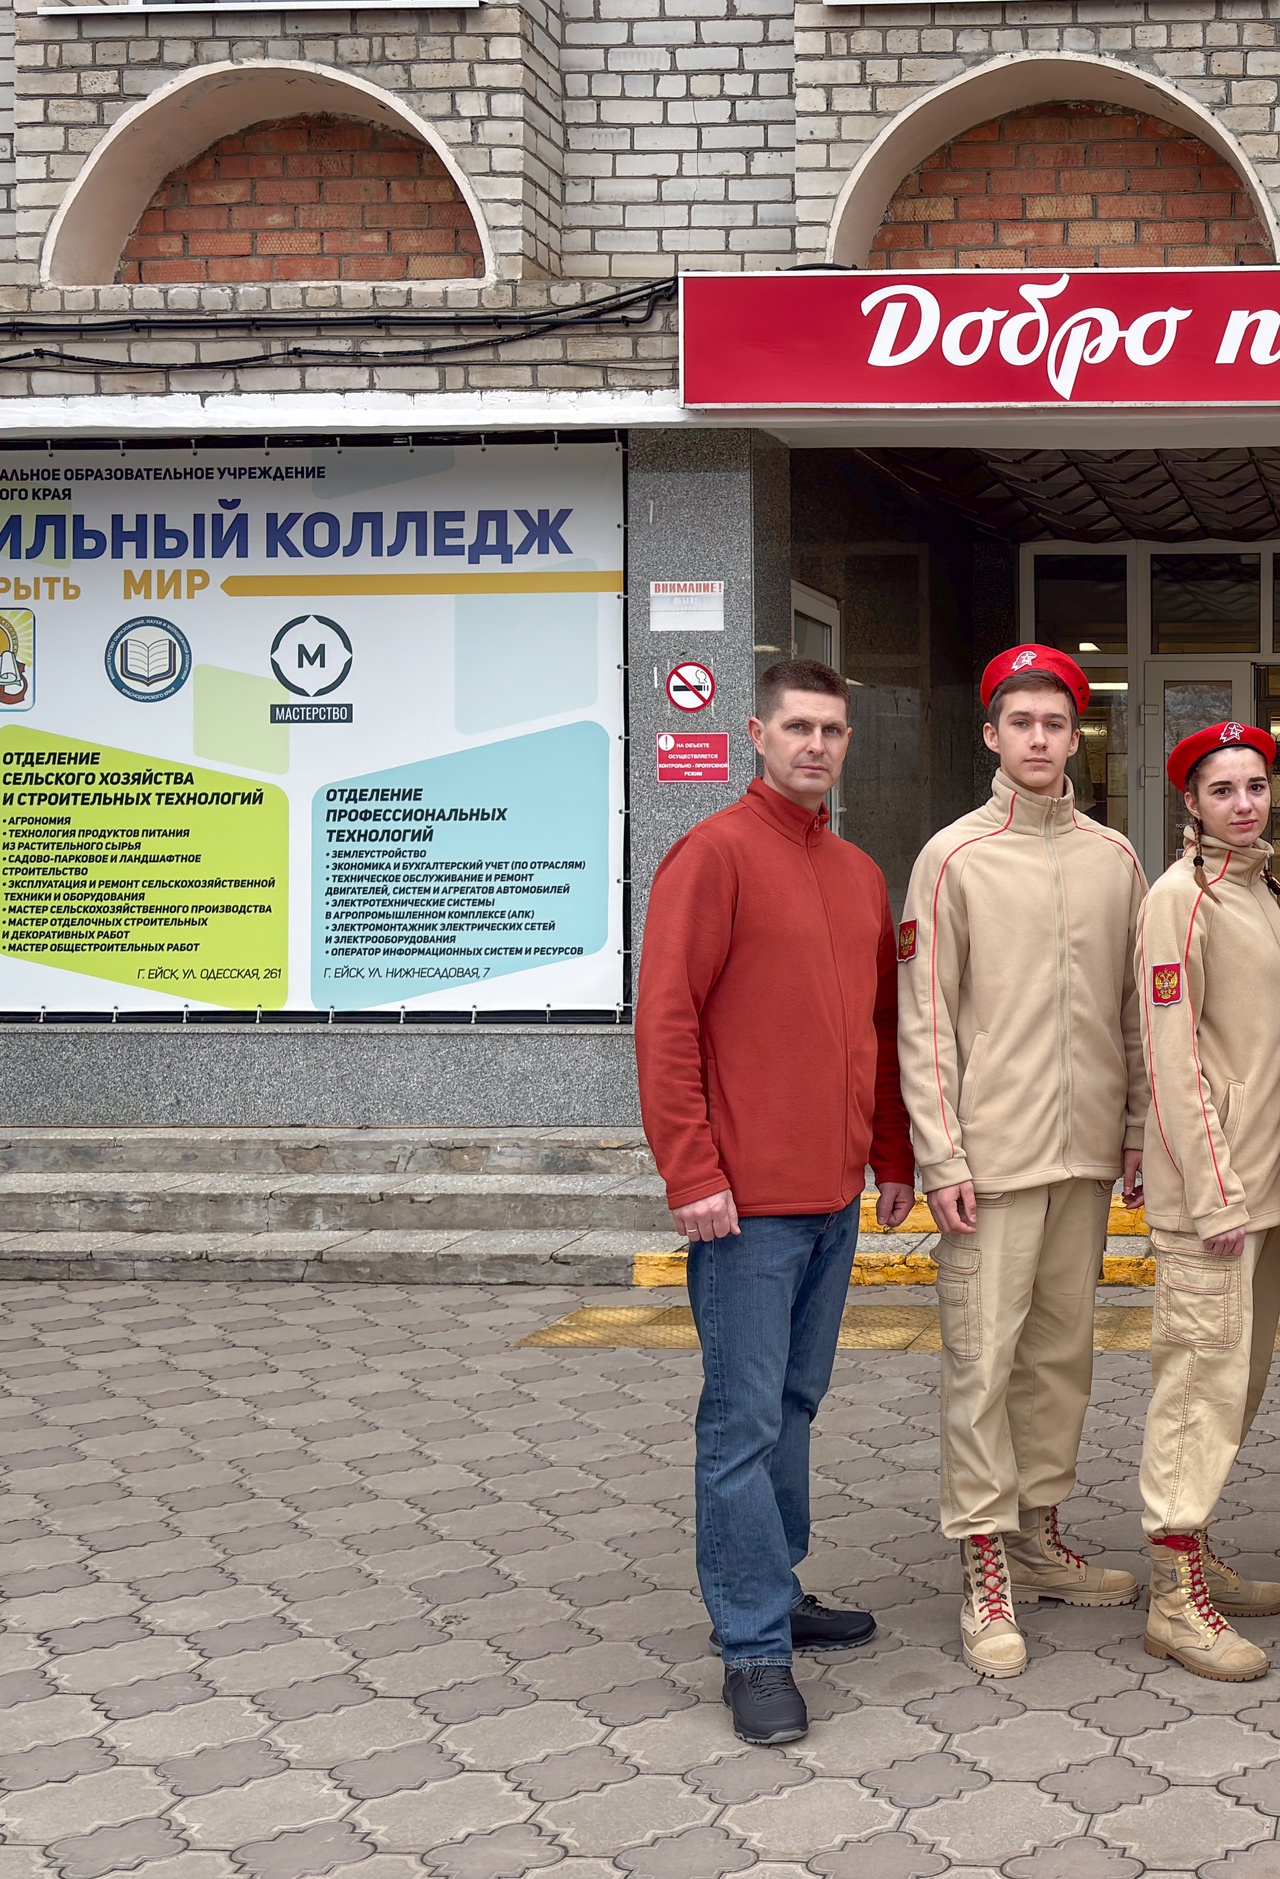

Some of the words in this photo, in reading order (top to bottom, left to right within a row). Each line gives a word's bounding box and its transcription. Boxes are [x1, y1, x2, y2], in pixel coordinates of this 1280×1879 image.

[861, 273, 1193, 401] Добро
[0, 467, 61, 482] АЛЬНОЕ
[63, 466, 215, 481] ОБРАЗОВАТЕЛЬНОЕ
[217, 465, 326, 481] УЧРЕЖДЕНИЕ
[31, 487, 72, 501] КРАЯ
[265, 508, 573, 564] КОЛЛЕДЖ
[123, 568, 210, 599] МИР
[654, 583, 722, 593] ВНИМАНИЕ!
[275, 705, 348, 722] МАСТЕРСТВО
[2, 752, 100, 767] ОТДЕЛЕНИЕ
[2, 772, 96, 785] СЕЛЬСКОГО
[100, 770, 194, 785] ХОЗЯЙСТВА
[2, 793, 14, 805] И
[17, 792, 152, 806] СТРОИТЕЛЬНЫХ
[156, 789, 264, 805] ТЕХНОЛОГИЙ
[326, 788, 423, 803] ОТДЕЛЕНИЕ
[325, 807, 508, 822] ПРОФЕССИОНАЛЬНЫХ
[8, 817, 71, 825] АГРОНОМИЯ
[9, 829, 76, 838] ТЕХНОЛОГИЯ
[78, 829, 139, 839] ПРОДУКТОВ
[141, 829, 190, 837] ПИТАНИЯ
[327, 826, 434, 843] ТЕХНОЛОГИЙ
[2, 842, 16, 850] ИЗ
[17, 842, 103, 850] РАСТИТЕЛЬНОГО
[105, 842, 141, 850] СЫРЬЯ
[331, 848, 427, 858] ЗЕМЛЕУСТРОЙСТВО
[8, 854, 108, 864] САДОВО-ПАРКОВОЕ
[110, 854, 118, 863] И
[119, 854, 201, 864] ЛАНДШАФТНОЕ
[331, 862, 392, 871] ЭКОНОМИКА
[393, 862, 401, 870] И
[402, 859, 483, 871] БУХГАЛТЕРСКИЙ
[484, 861, 509, 870] УЧЕТ
[511, 861, 528, 871] (ПО
[530, 860, 586, 870] ОТРАСЛЯМ)
[2, 867, 88, 876] СТРОИТЕЛЬСТВО
[8, 880, 87, 889] ЭКСПЛУАТАЦИЯ
[89, 880, 97, 888] И
[99, 880, 140, 888] РЕМОНТ
[142, 878, 275, 888] СЕЛЬСКОХОЗЯЙСТВЕННОЙ
[332, 874, 401, 883] ТЕХНИЧЕСКОЕ
[402, 874, 483, 883] ОБСЛУЖИВАНИЕ
[485, 874, 493, 882] И
[494, 873, 534, 882] РЕМОНТ
[325, 885, 390, 897] ДВИГАТЕЛЕЙ,
[392, 886, 431, 895] СИСТЕМ
[432, 886, 440, 895] И
[441, 886, 494, 895] АГРЕГАТОВ
[496, 884, 570, 894] АВТОМОБИЛЕЙ
[4, 893, 51, 901] ТЕХНИКИ
[53, 893, 61, 901] И
[63, 893, 145, 902] ОБОРУДОВАНИЯ
[331, 898, 445, 907] ЭЛЕКТРОТЕХНИЧЕСКИЕ
[447, 898, 495, 907] СИСТЕМЫ
[8, 905, 48, 914] МАСТЕР
[50, 903, 189, 914] СЕЛЬСКОХОЗЯЙСТВЕННОГО
[191, 904, 272, 914] ПРОИЗВОДСТВА
[325, 911, 332, 919] В
[332, 911, 446, 920] АГРОПРОМЫШЛЕННОМ
[448, 910, 506, 919] КОМПЛЕКСЕ
[507, 910, 535, 920] (АПК)
[8, 918, 48, 926] МАСТЕР
[50, 918, 122, 927] ОТДЕЛОЧНЫХ
[124, 918, 208, 926] СТРОИТЕЛЬНЫХ
[331, 923, 438, 932] ЭЛЕКТРОМОНТАЖНИК
[439, 923, 523, 932] ЭЛЕКТРИЧЕСКИХ
[524, 920, 555, 931] СЕТЕЙ
[2, 931, 10, 939] И
[11, 931, 95, 940] ДЕКОРАТИВНЫХ
[97, 931, 130, 939] РАБОТ
[325, 935, 332, 944] И
[333, 935, 456, 944] ЭЛЕКТРООБОРУДОВАНИЯ
[8, 943, 48, 952] МАСТЕР
[50, 943, 164, 953] ОБЩЕСТРОИТЕЛЬНЫХ
[167, 943, 200, 951] РАБОТ
[331, 948, 381, 956] ОПЕРАТОР
[382, 948, 483, 957] ИНФОРМАЦИОННЫХ
[484, 947, 522, 956] СИСТЕМ
[524, 947, 532, 956] И
[533, 947, 583, 956] РЕСУРСОВ
[137, 969, 145, 979] Г.
[148, 966, 179, 981] ЕЙСК,
[182, 969, 198, 979] УЛ.
[200, 968, 260, 980] ОДЕССКАЯ,
[263, 969, 282, 979] 261
[323, 968, 332, 978] Г.
[334, 965, 365, 980] ЕЙСК,
[368, 968, 383, 978] УЛ.
[385, 967, 481, 980] НИЖНЕСАДОВАЯ,
[482, 967, 490, 978] 7
